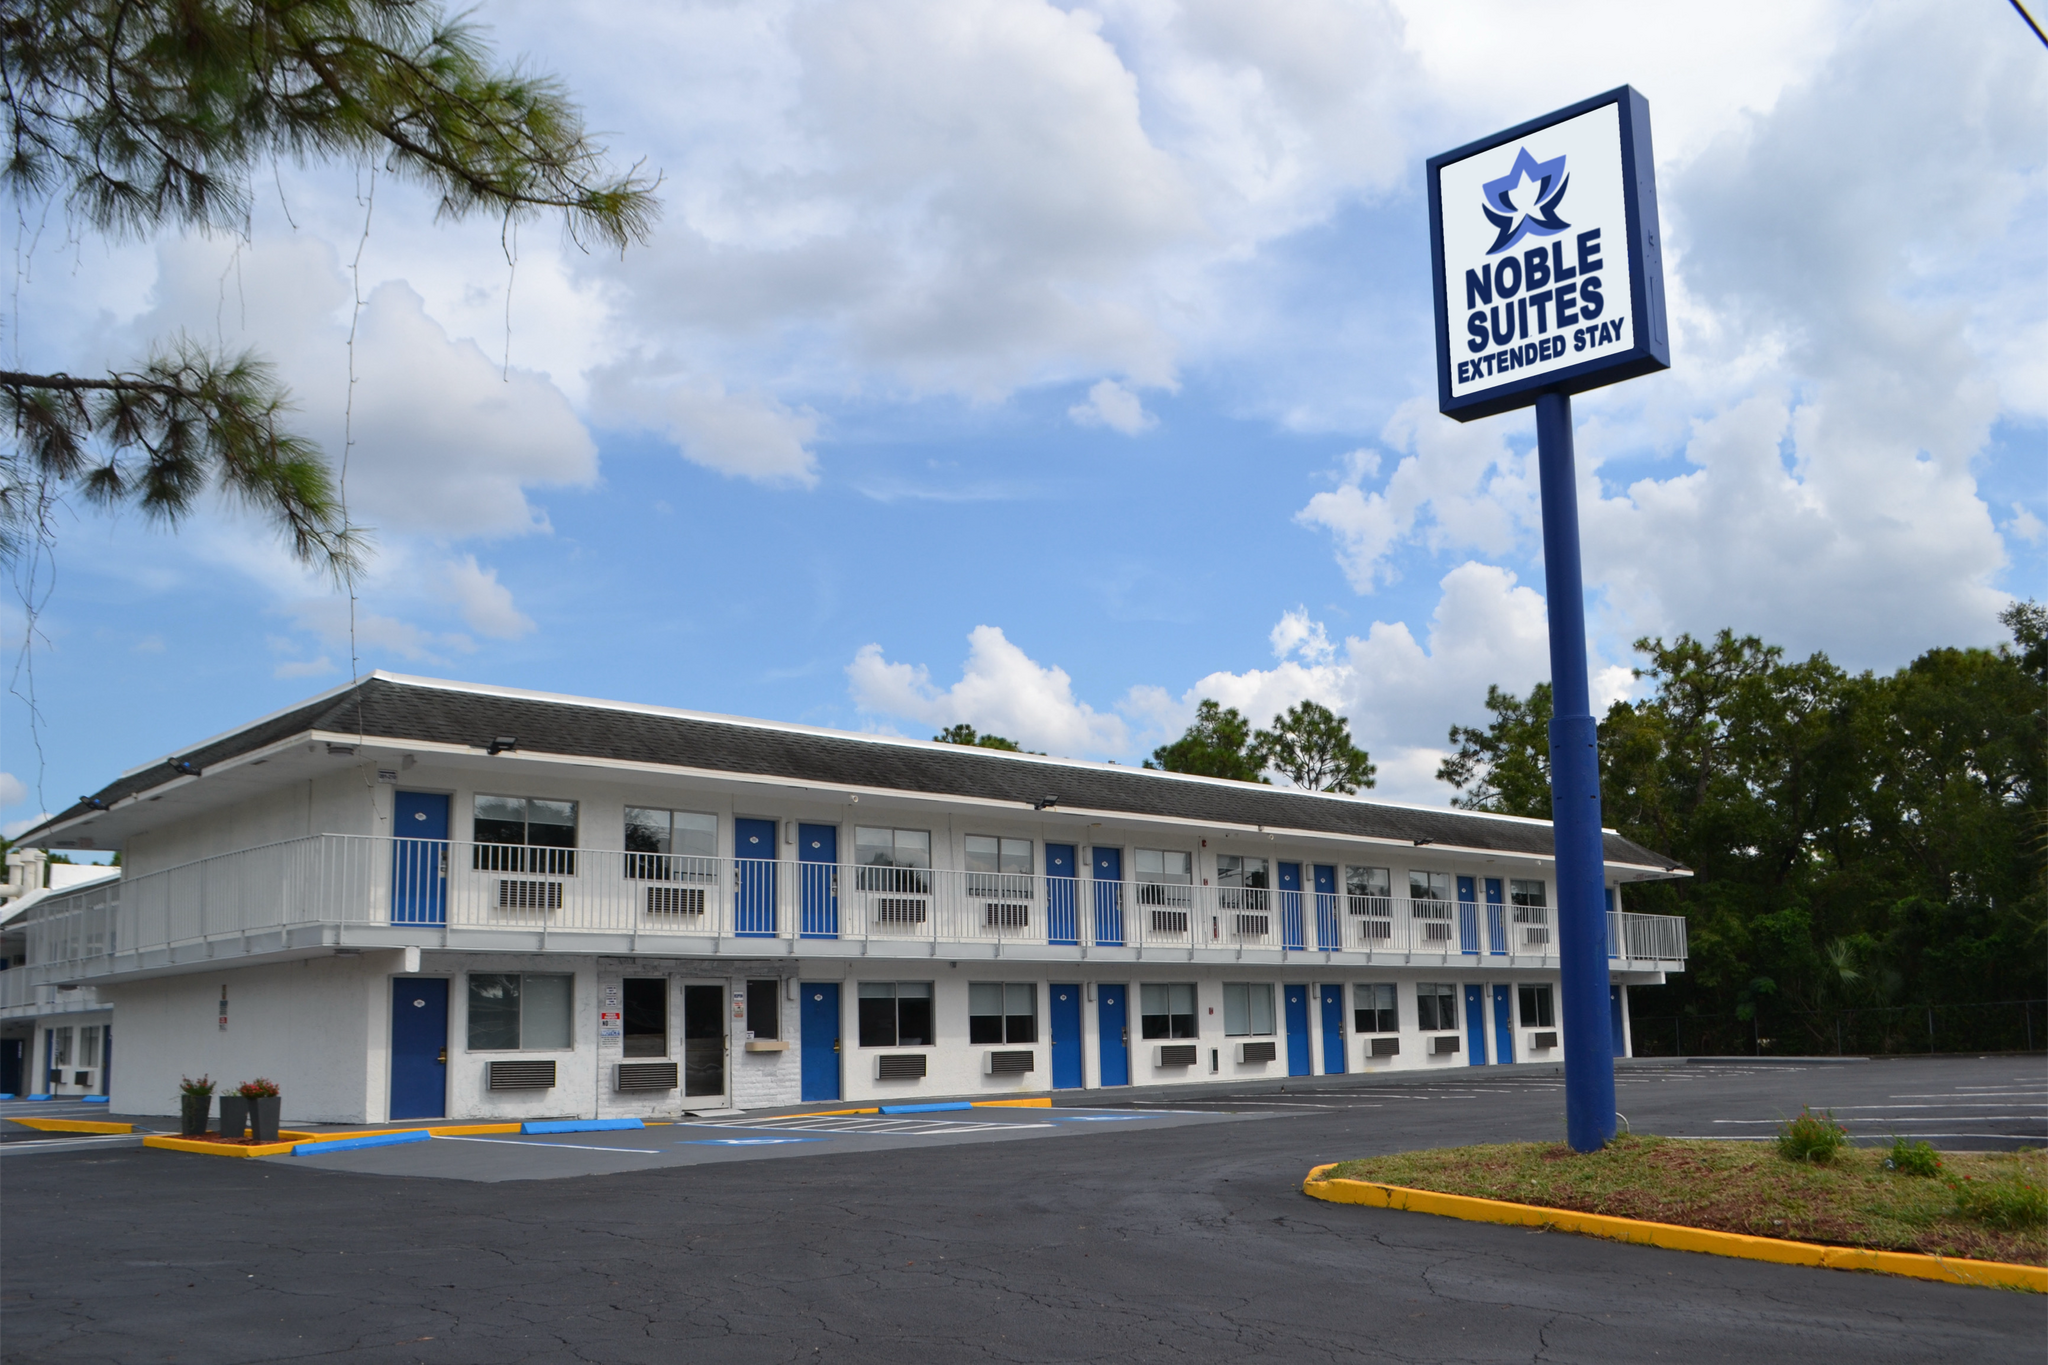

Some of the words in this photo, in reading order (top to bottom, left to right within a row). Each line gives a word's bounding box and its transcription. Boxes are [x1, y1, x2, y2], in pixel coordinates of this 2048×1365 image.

[1465, 227, 1604, 311] NOBLE
[1457, 334, 1567, 385] EXTENDED
[1573, 316, 1625, 352] STAY
[1467, 275, 1605, 354] SUITES
